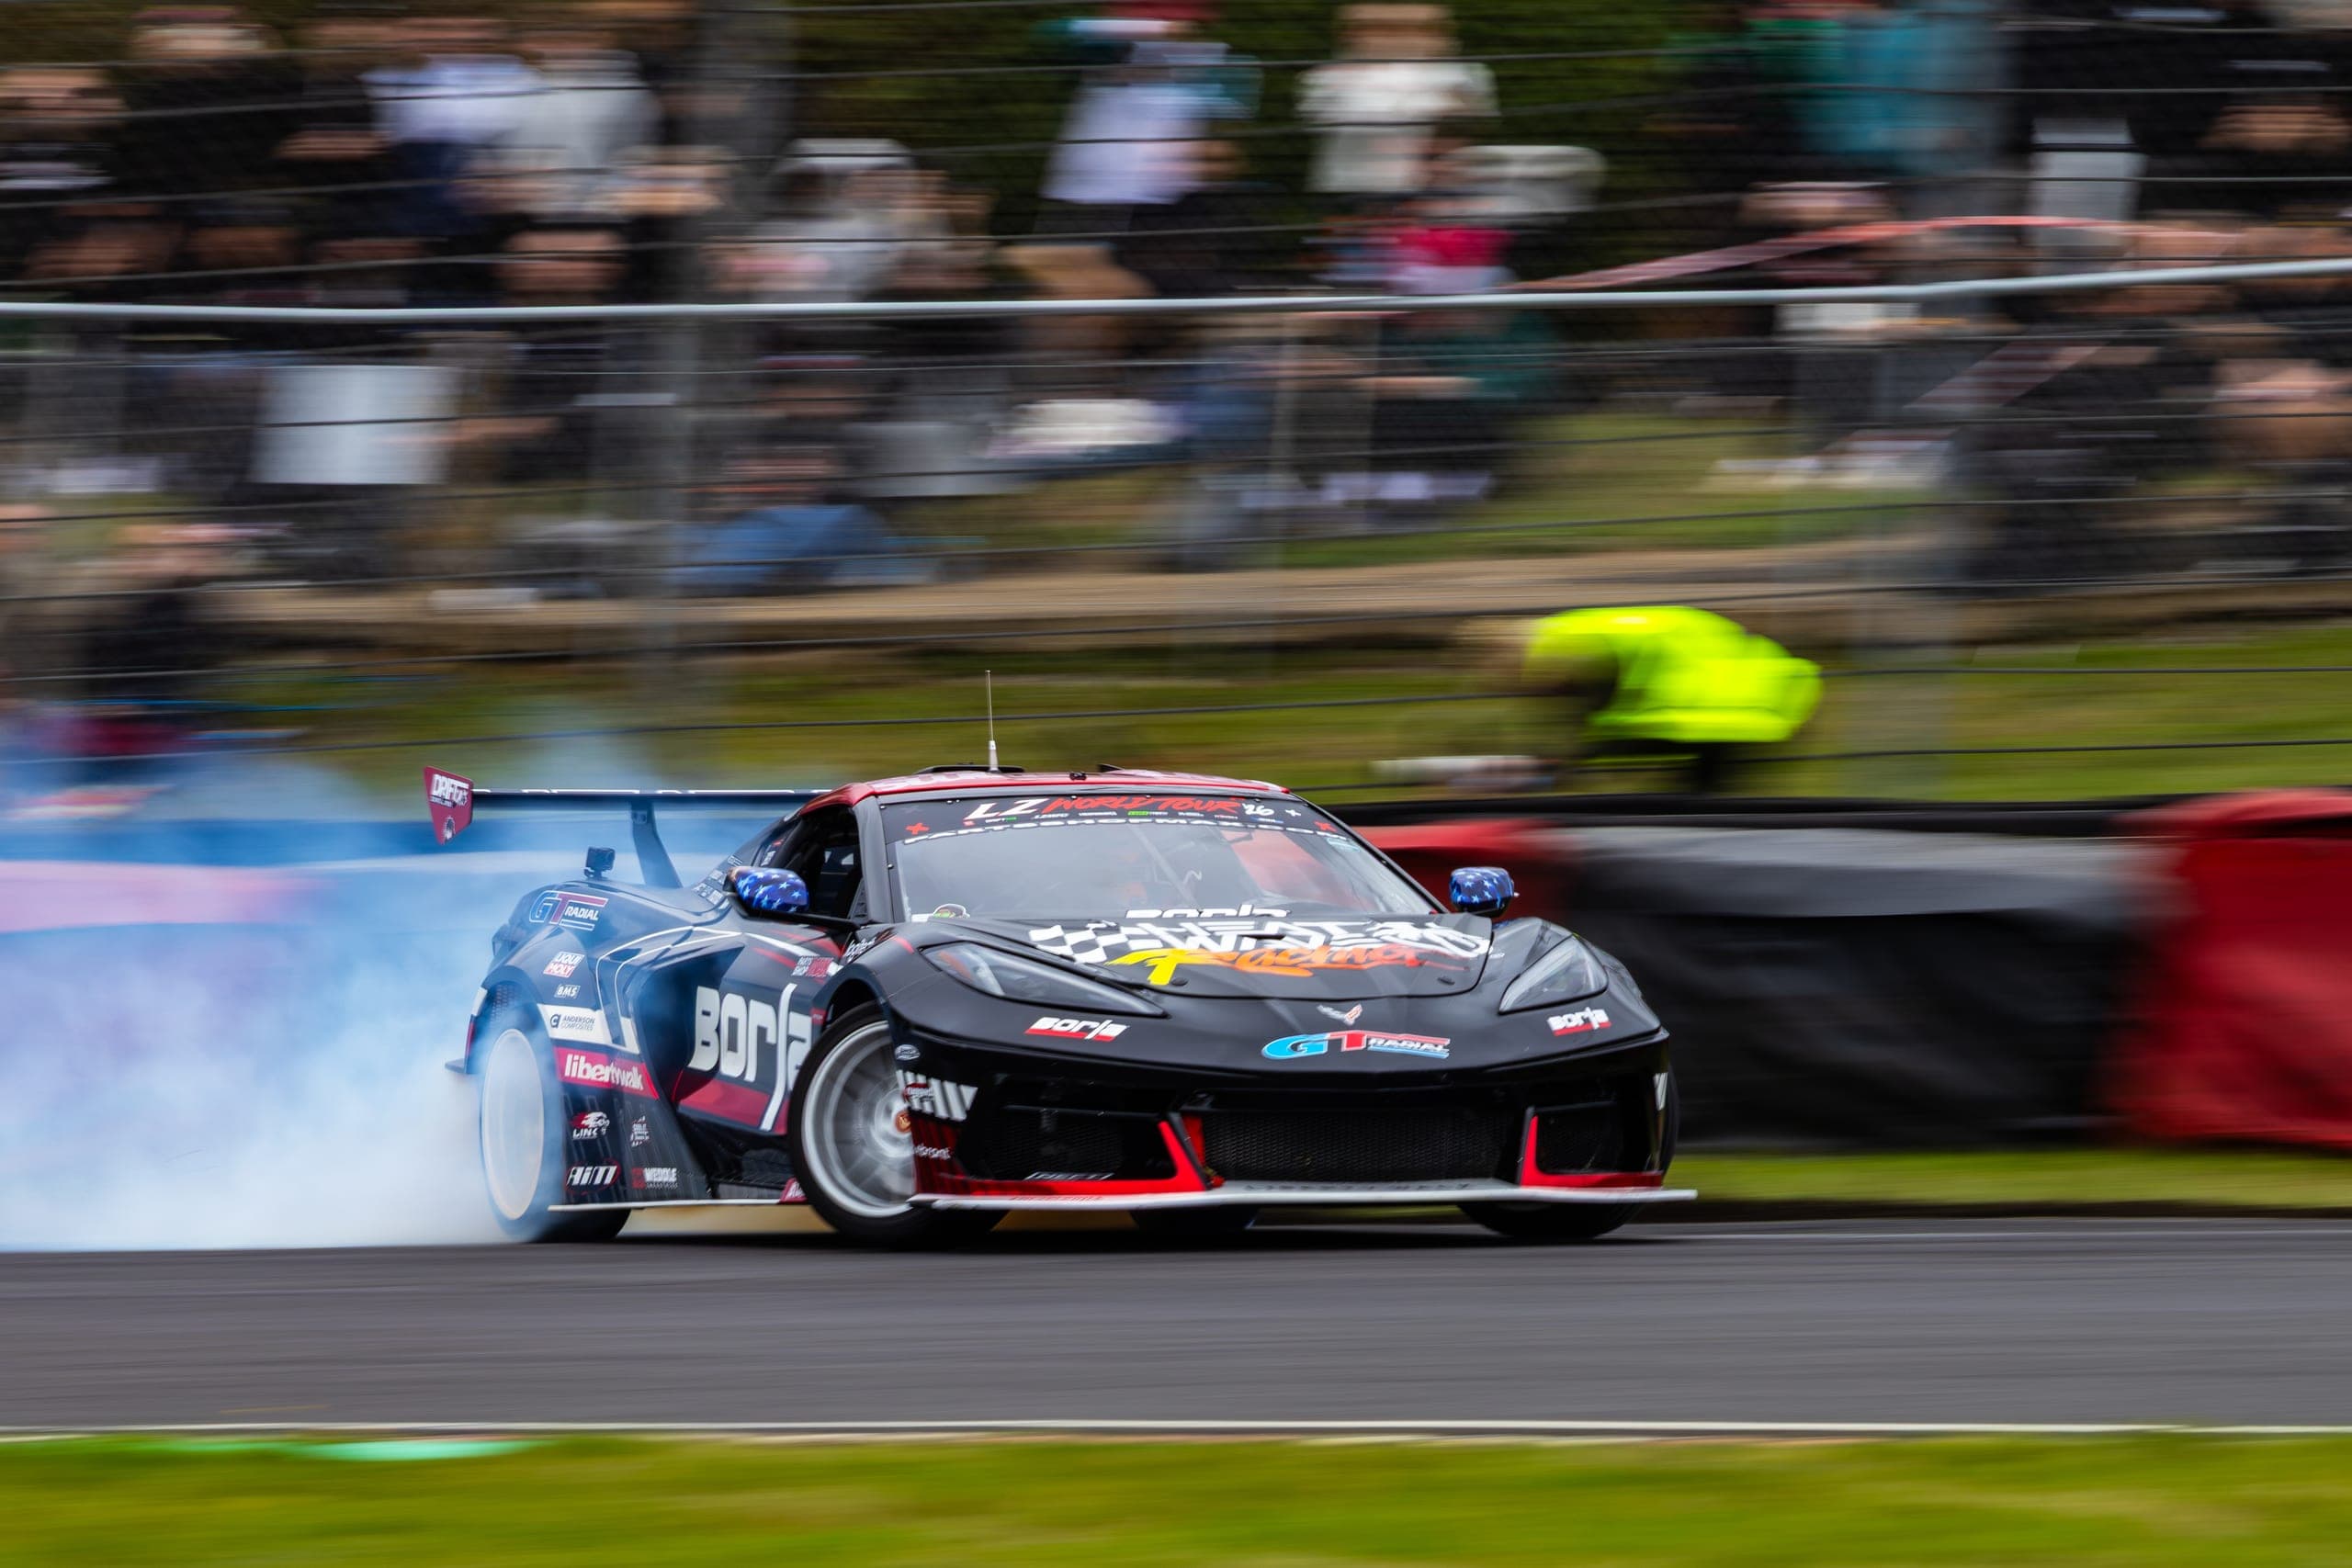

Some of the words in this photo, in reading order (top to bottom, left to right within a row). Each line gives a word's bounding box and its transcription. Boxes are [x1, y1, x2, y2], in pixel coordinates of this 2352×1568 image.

[965, 798, 1050, 820] LZ
[1153, 797, 1242, 814] TOUR
[565, 906, 599, 921] RADIAL
[555, 953, 582, 964] LIQUI
[548, 962, 575, 974] MOLY
